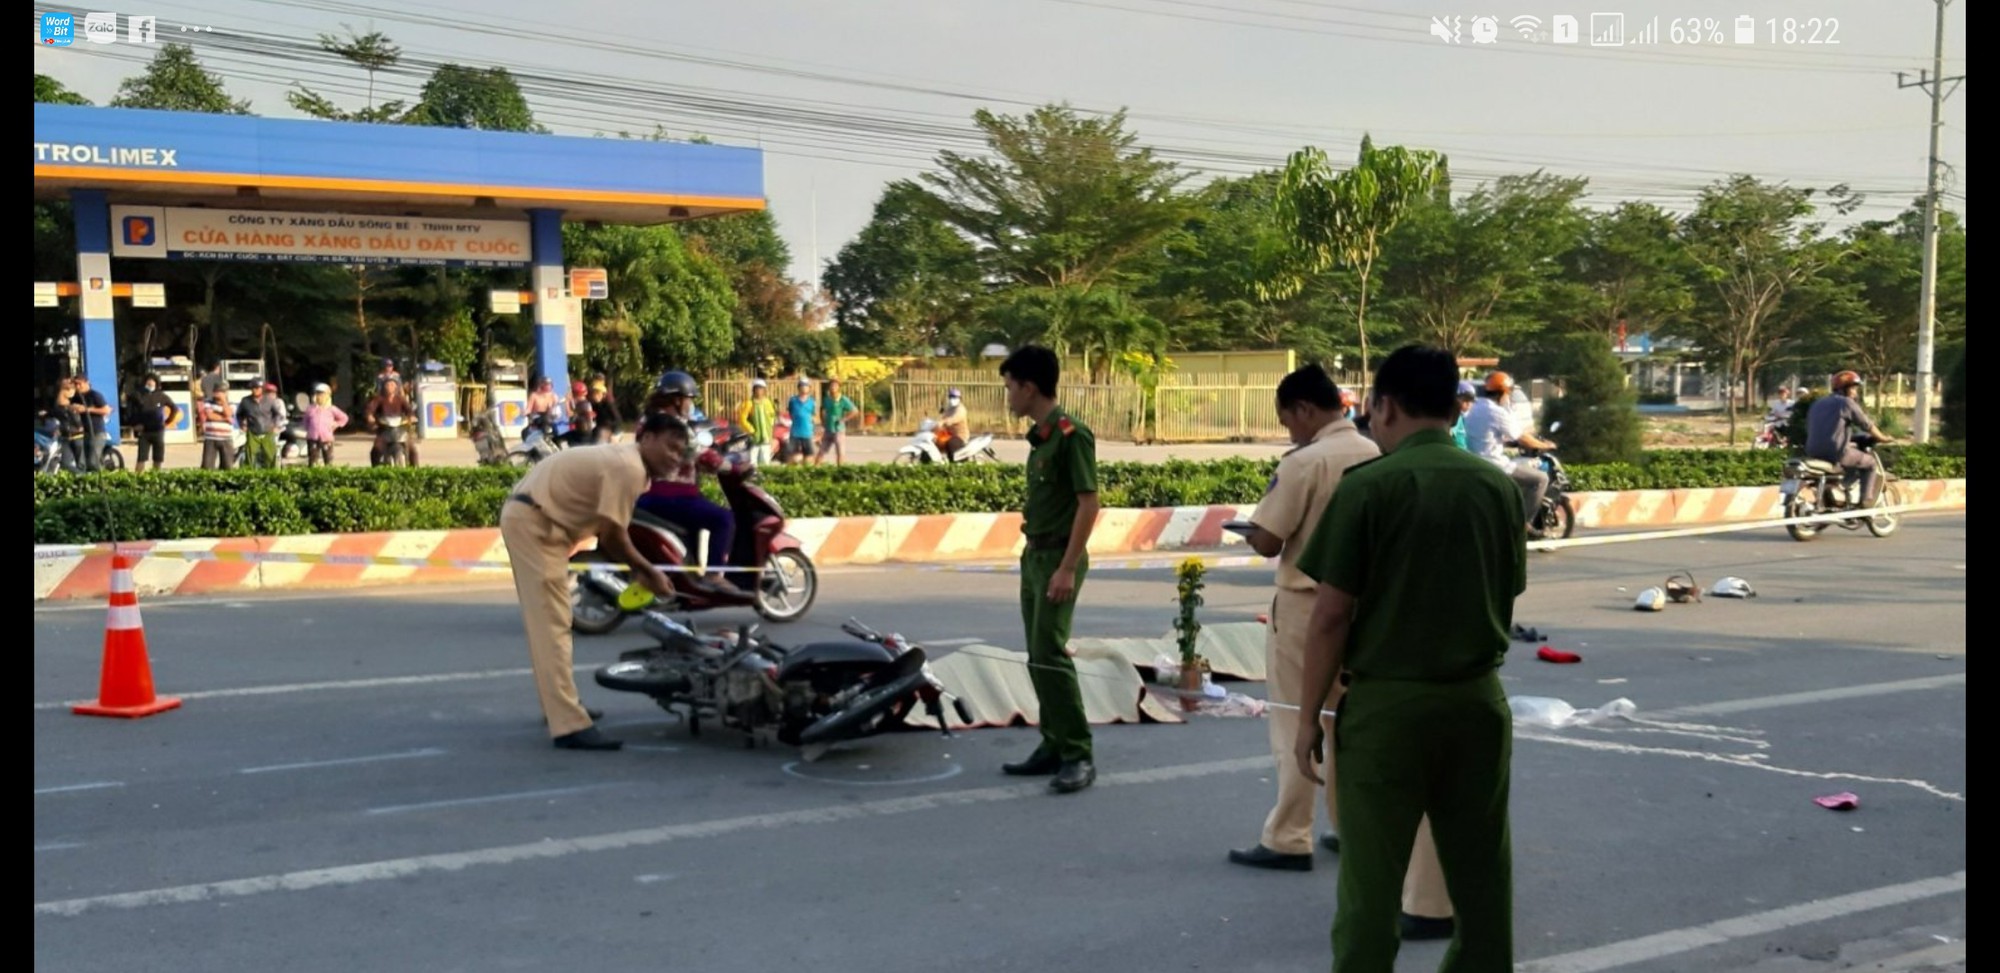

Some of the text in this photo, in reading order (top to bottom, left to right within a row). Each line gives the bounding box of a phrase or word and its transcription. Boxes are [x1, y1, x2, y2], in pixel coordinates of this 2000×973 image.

[34, 142, 177, 166] TROLIMEX
[228, 215, 265, 225] CÔNG
[270, 217, 285, 225] TY
[183, 226, 520, 255] CỬA HÀNG XĂNG DẦU ĐẤT CUỐC
